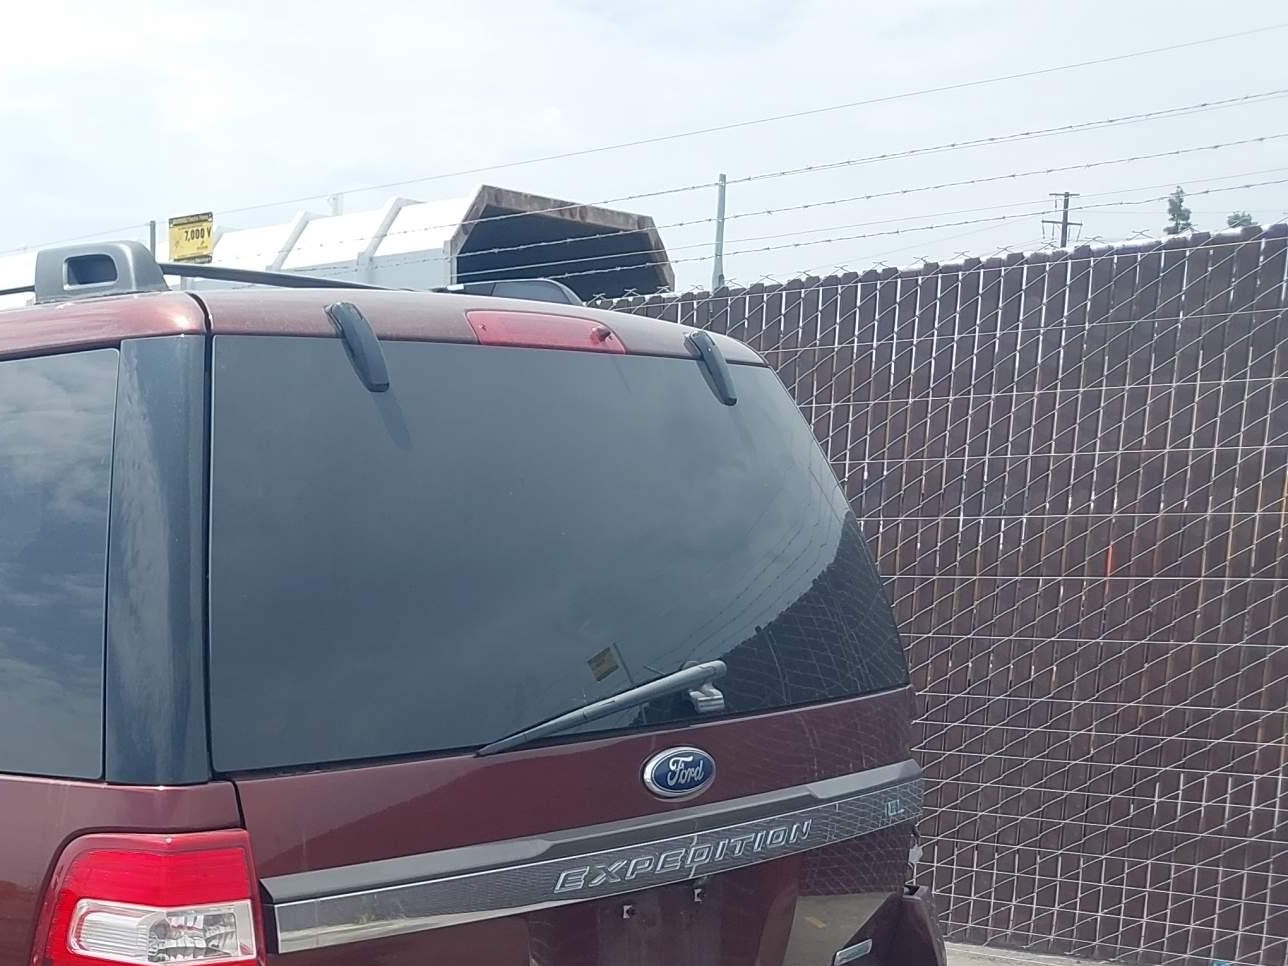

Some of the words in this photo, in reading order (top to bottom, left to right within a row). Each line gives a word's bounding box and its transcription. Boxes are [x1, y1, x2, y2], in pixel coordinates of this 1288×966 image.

[184, 228, 205, 241] 7,000
[667, 756, 705, 786] Ford
[554, 819, 812, 894] EXPEDITION
